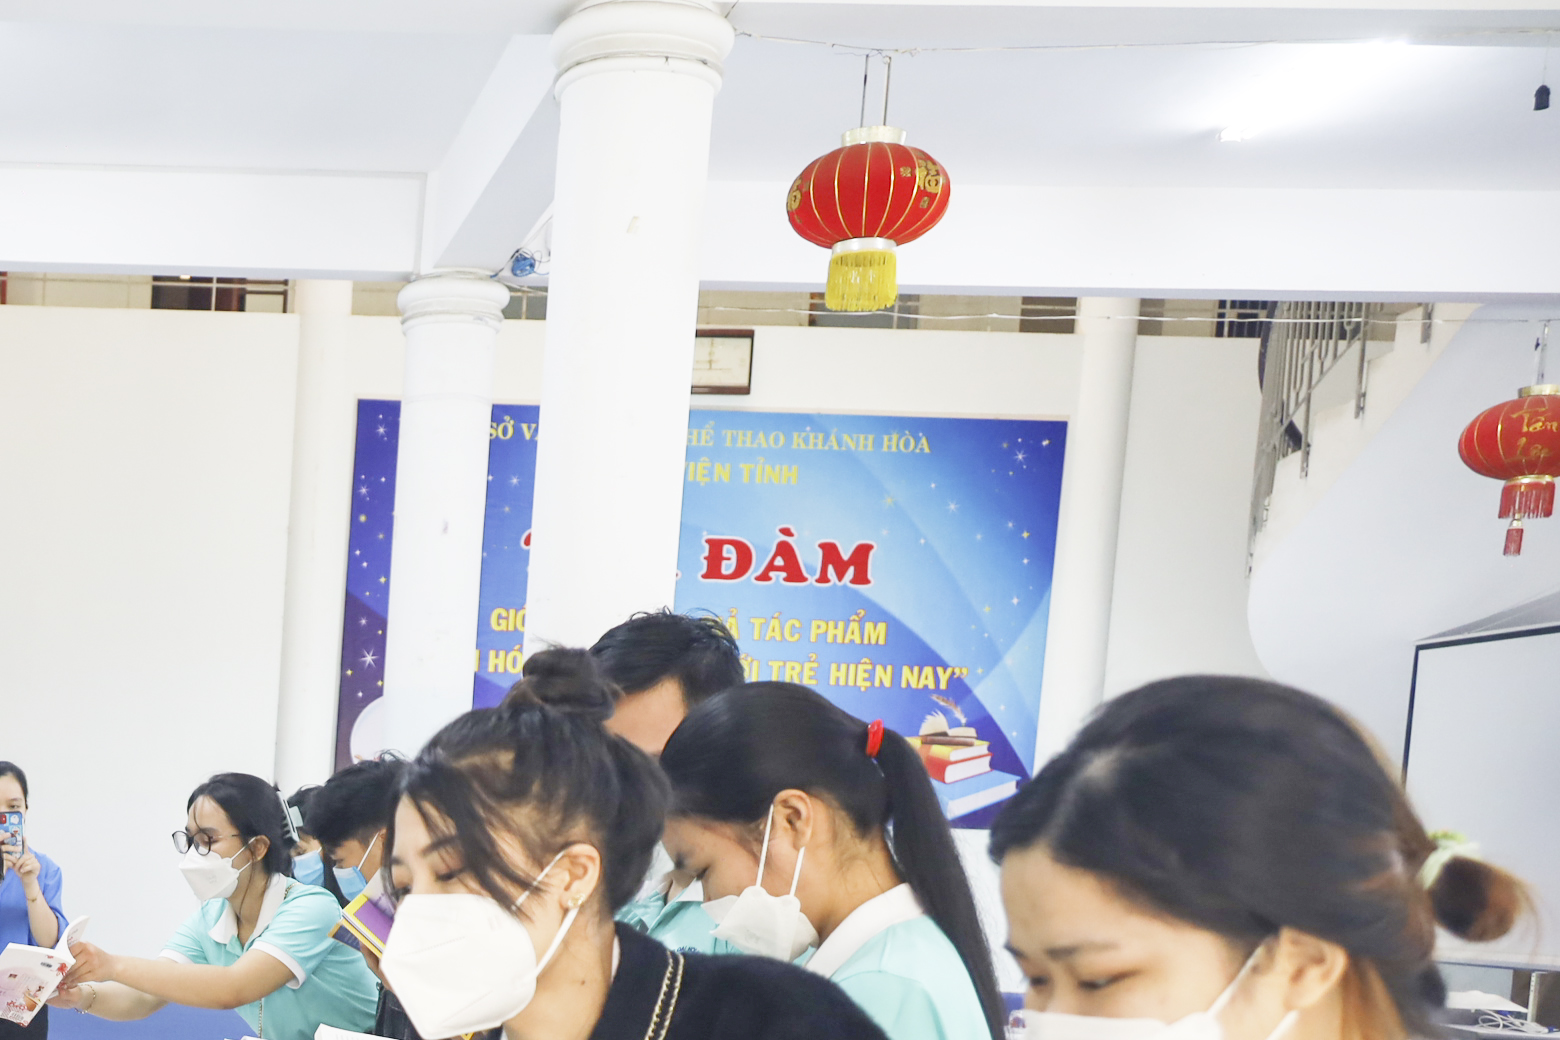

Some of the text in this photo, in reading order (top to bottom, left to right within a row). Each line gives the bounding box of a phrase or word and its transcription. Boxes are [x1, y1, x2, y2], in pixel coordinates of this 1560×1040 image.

[722, 429, 785, 449] THAO
[791, 427, 875, 452] KHÁNH
[882, 430, 931, 454] HÒA
[740, 456, 798, 485] TỈNH
[701, 526, 874, 585] ĐÀM
[751, 609, 801, 642] TÁC
[810, 608, 887, 646] PHẨM
[768, 652, 819, 685] TRẺ
[829, 657, 893, 688] HIỆN
